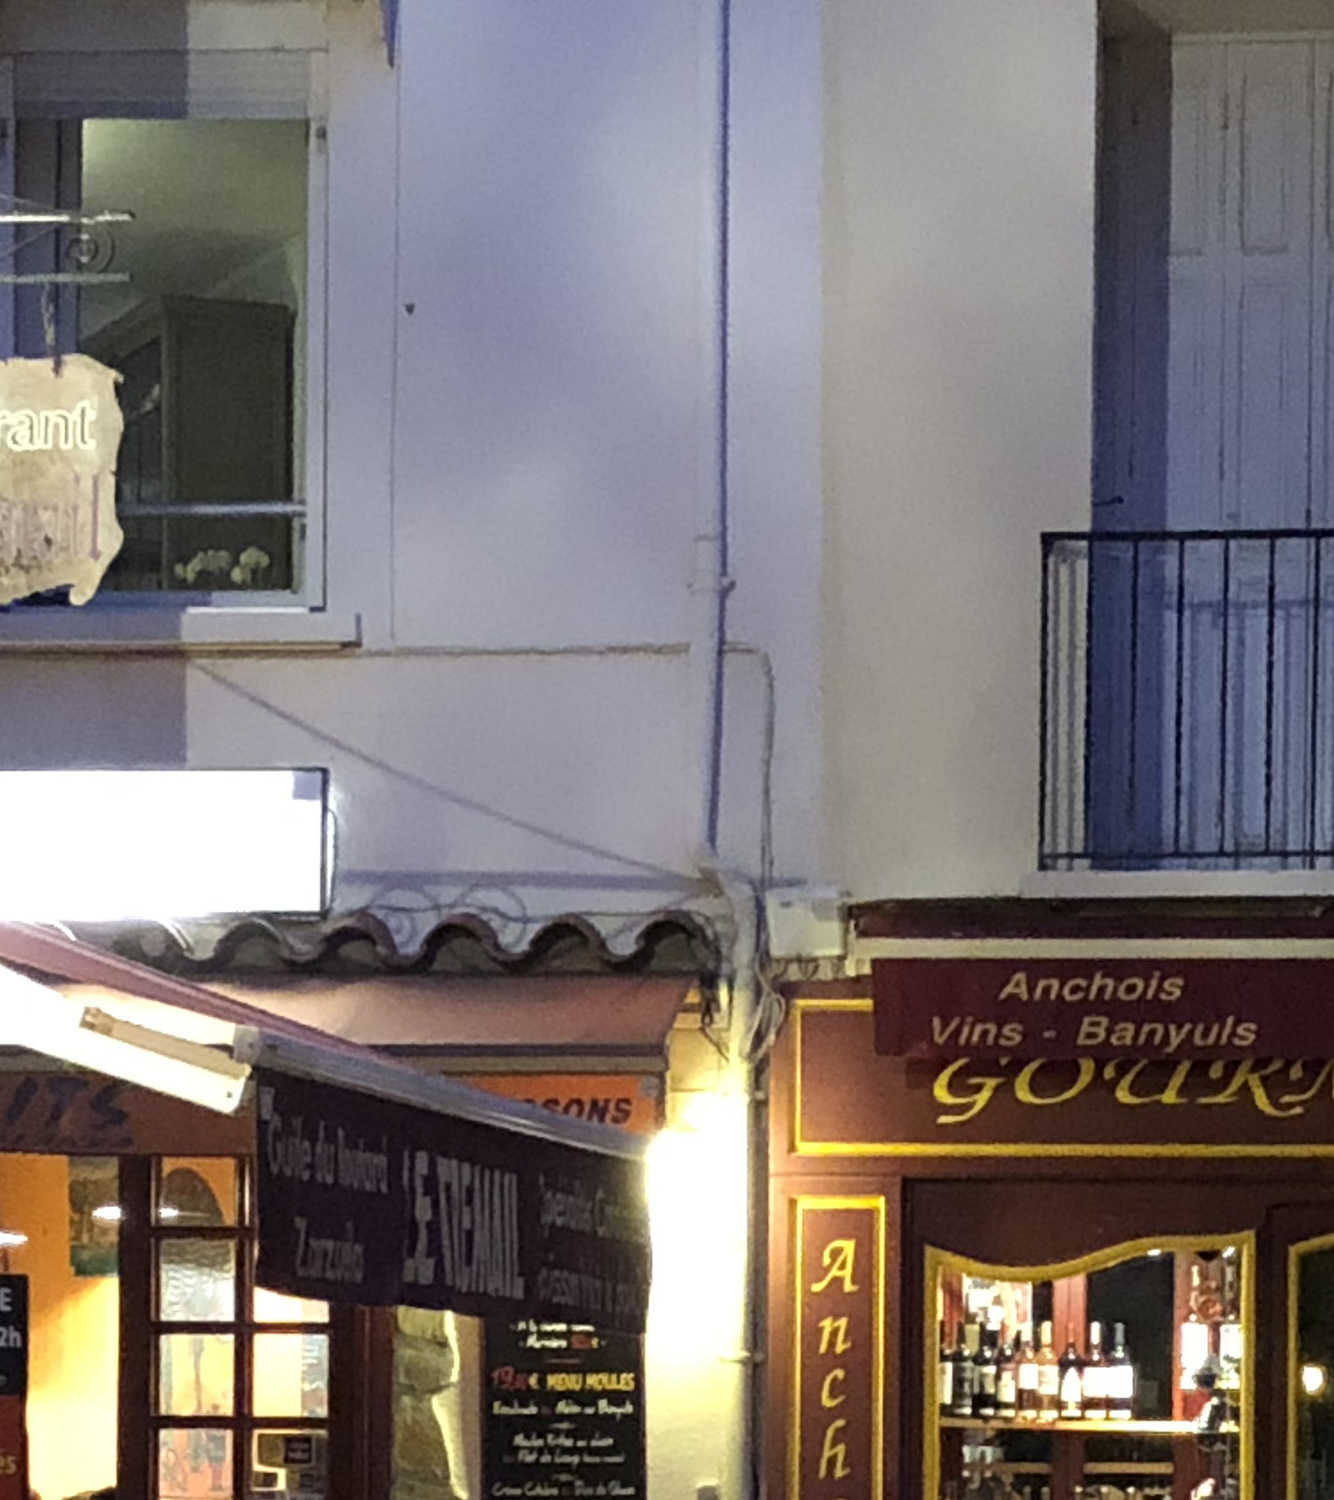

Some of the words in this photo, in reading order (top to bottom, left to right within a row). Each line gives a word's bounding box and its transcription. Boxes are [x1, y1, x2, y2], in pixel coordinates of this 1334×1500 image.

[998, 971, 1185, 1002] Anchois
[930, 1016, 1023, 1048] Vins
[1075, 1015, 1258, 1053] Banyuls
[524, 1096, 633, 1125] SONS
